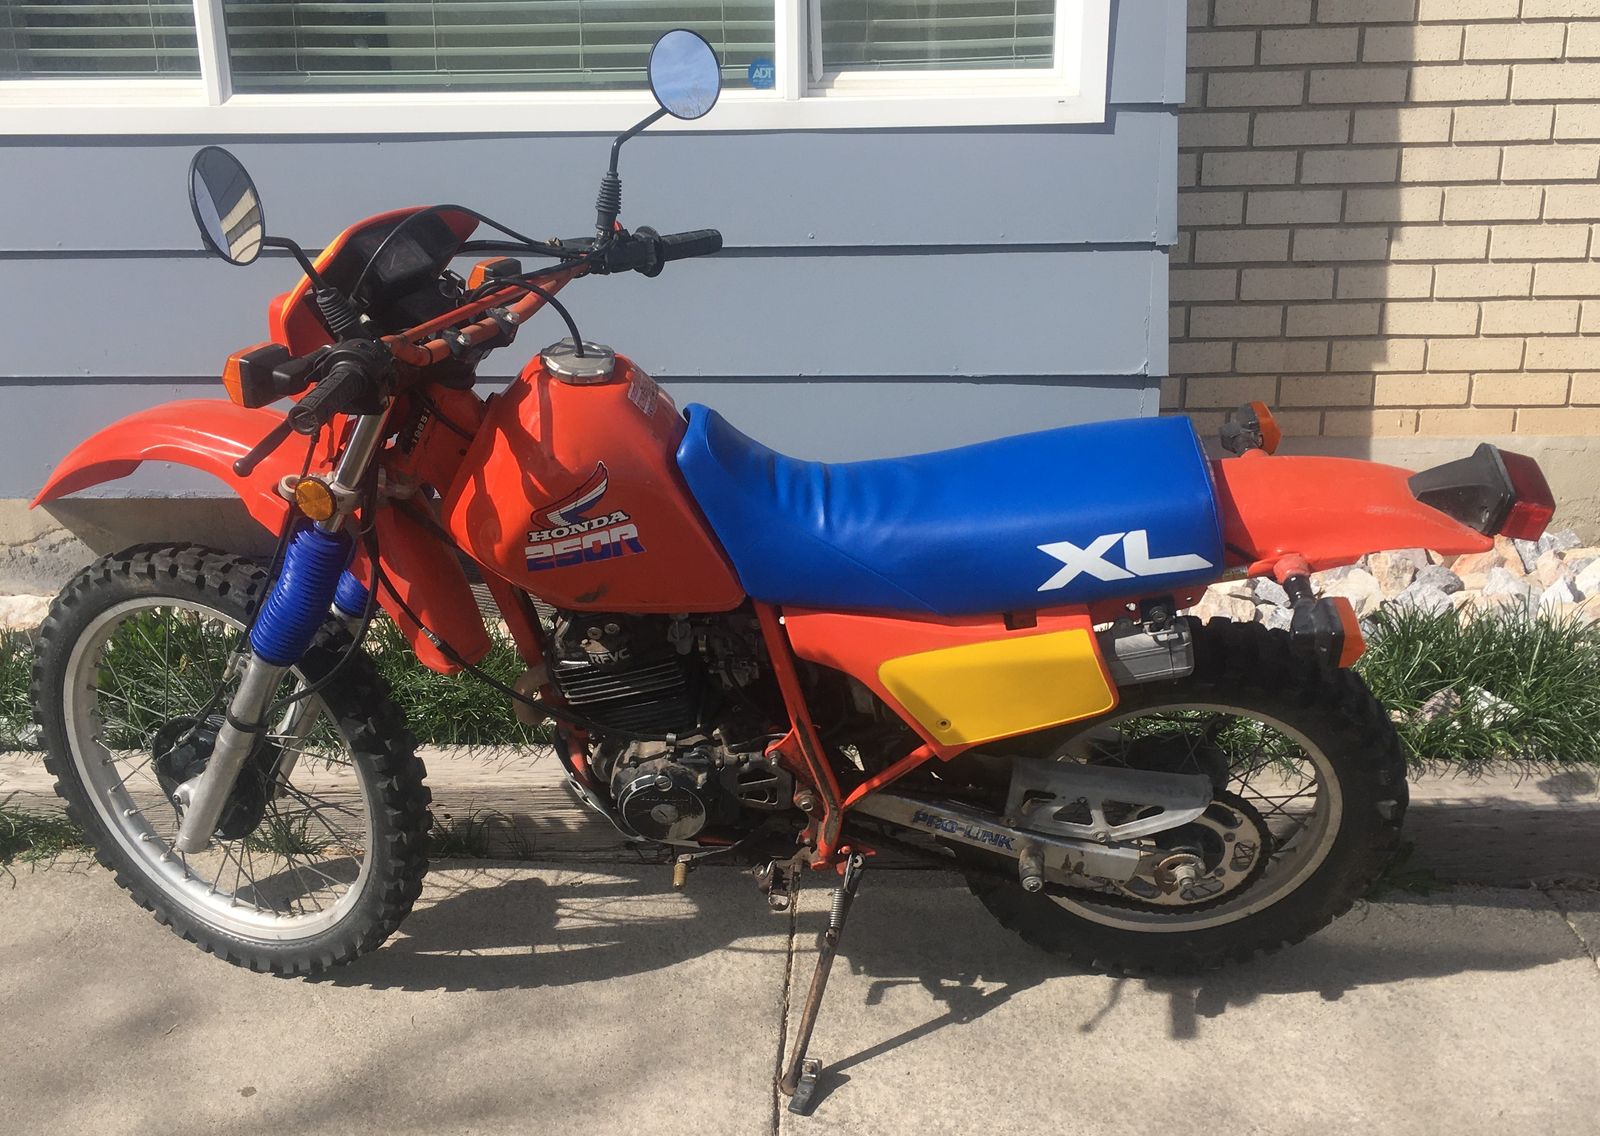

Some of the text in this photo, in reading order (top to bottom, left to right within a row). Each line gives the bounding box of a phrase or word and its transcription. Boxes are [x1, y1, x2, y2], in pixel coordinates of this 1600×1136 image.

[753, 67, 774, 79] ADT
[528, 510, 630, 542] HONDA
[525, 523, 647, 572] 250R
[1036, 529, 1214, 592] XL
[588, 647, 630, 664] RFVC
